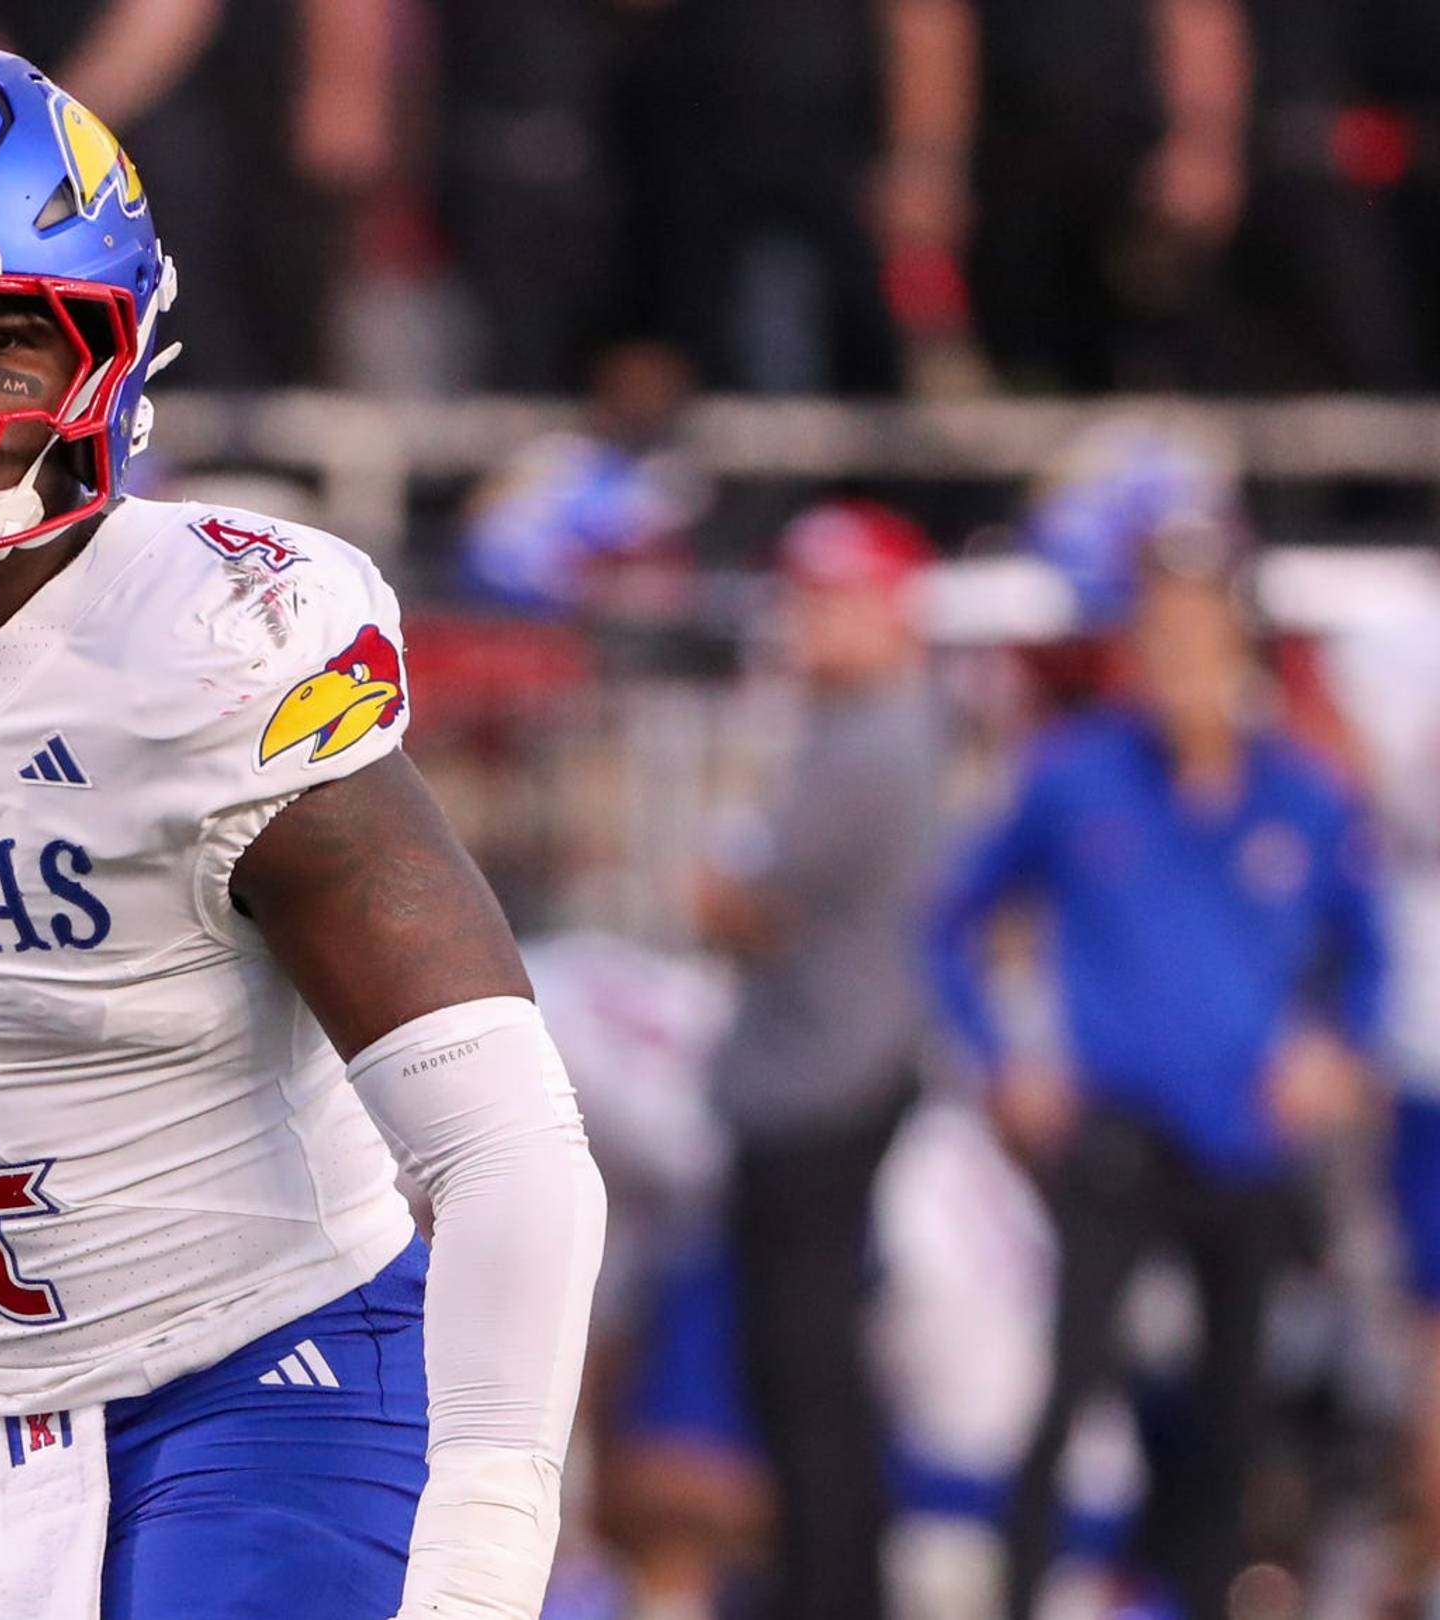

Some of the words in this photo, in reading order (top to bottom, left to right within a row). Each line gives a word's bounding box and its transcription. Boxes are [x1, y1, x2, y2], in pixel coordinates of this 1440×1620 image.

[2, 378, 29, 396] AM
[187, 514, 311, 573] 4
[402, 1041, 481, 1078] AEROREADY
